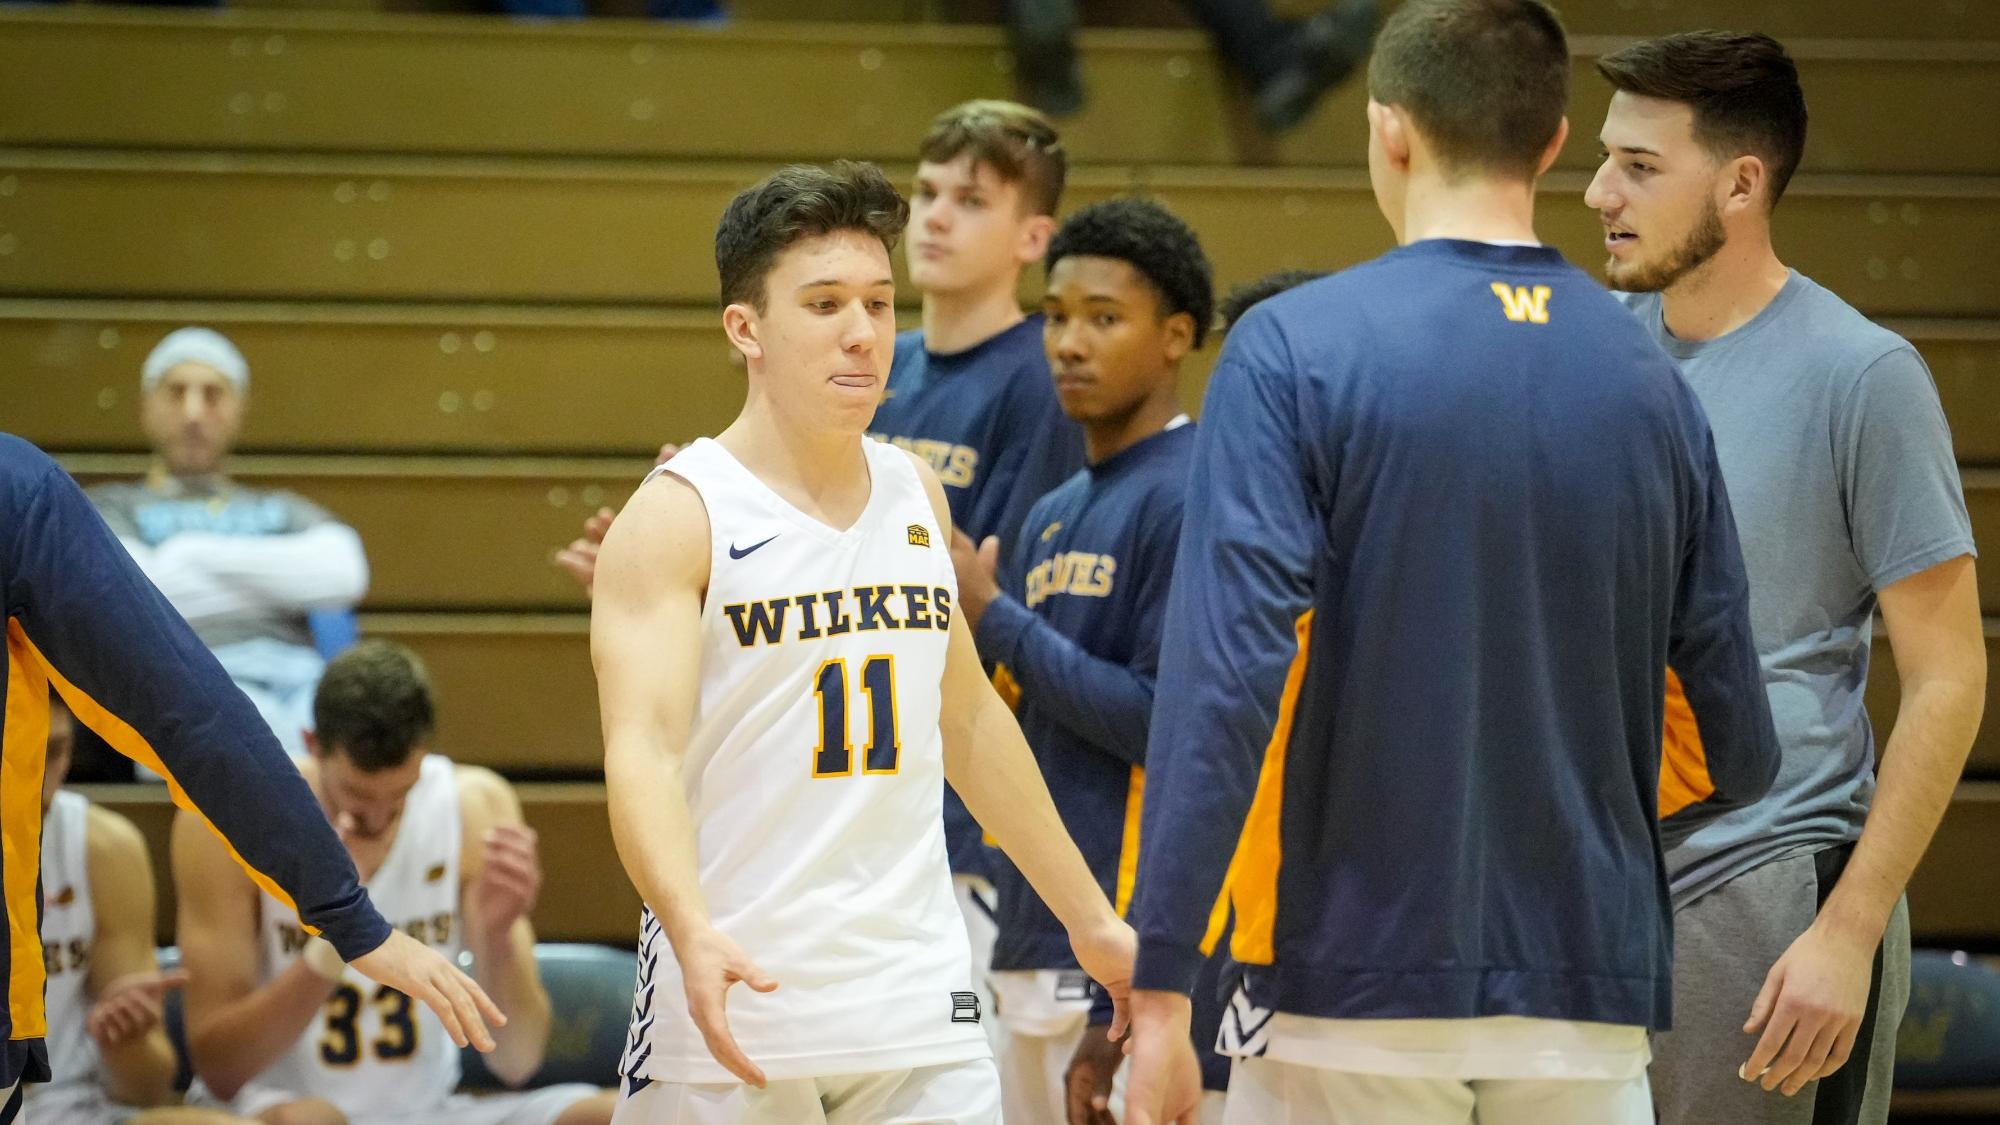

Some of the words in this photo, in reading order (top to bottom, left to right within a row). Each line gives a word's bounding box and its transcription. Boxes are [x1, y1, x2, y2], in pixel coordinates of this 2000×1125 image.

[1490, 282, 1552, 324] W
[724, 584, 950, 648] WILKES
[811, 654, 901, 779] 11
[318, 982, 420, 1067] 33
